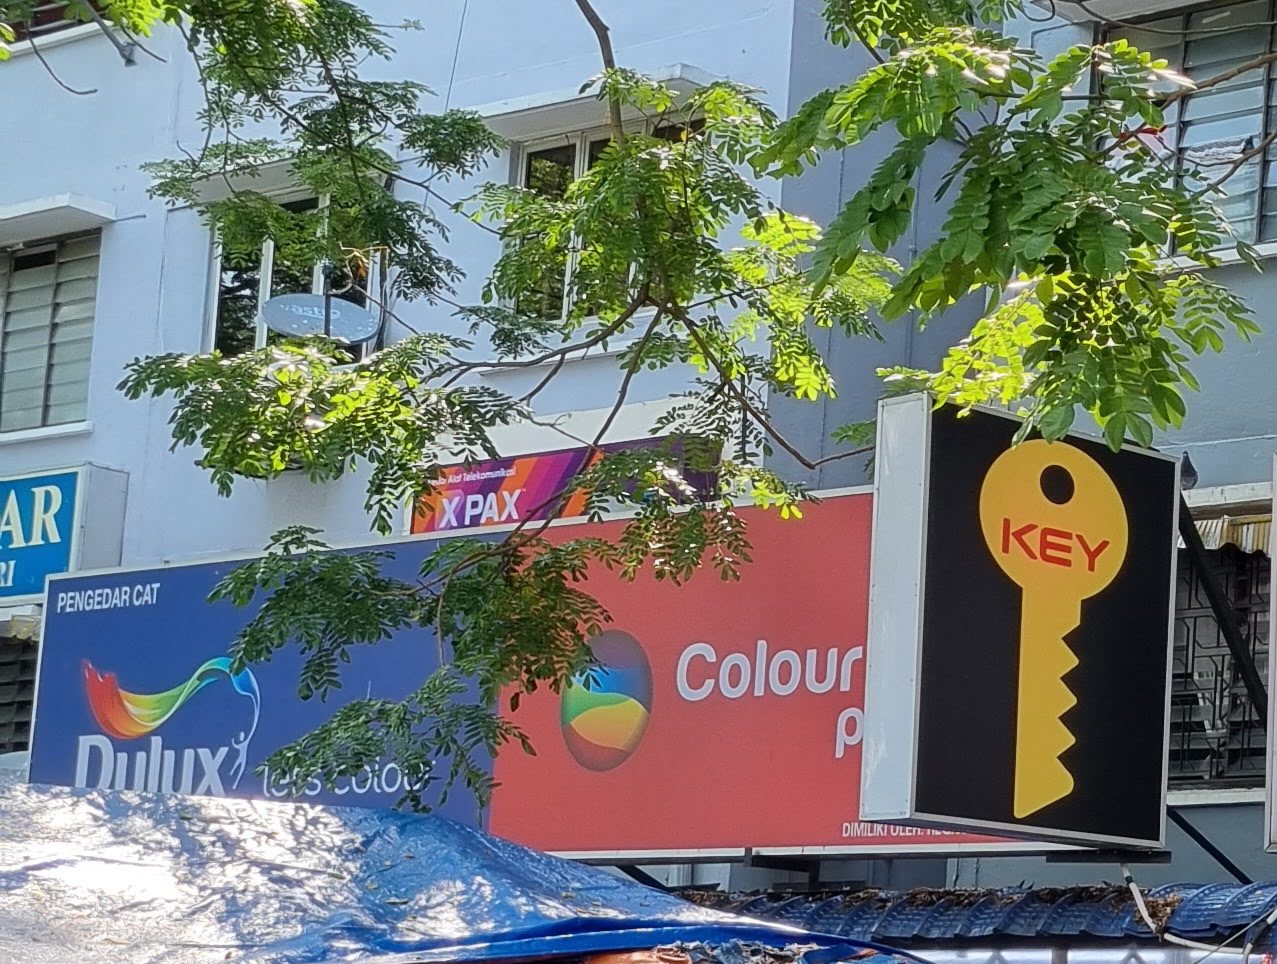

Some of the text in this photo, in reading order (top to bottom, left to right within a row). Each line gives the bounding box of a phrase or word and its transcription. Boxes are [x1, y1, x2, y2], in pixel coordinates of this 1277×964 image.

[0, 485, 61, 549] AR
[1001, 517, 1110, 573] KEY
[57, 583, 160, 613] PENGEDAR CAT
[75, 735, 227, 796] Dulux
[334, 757, 437, 794] colou
